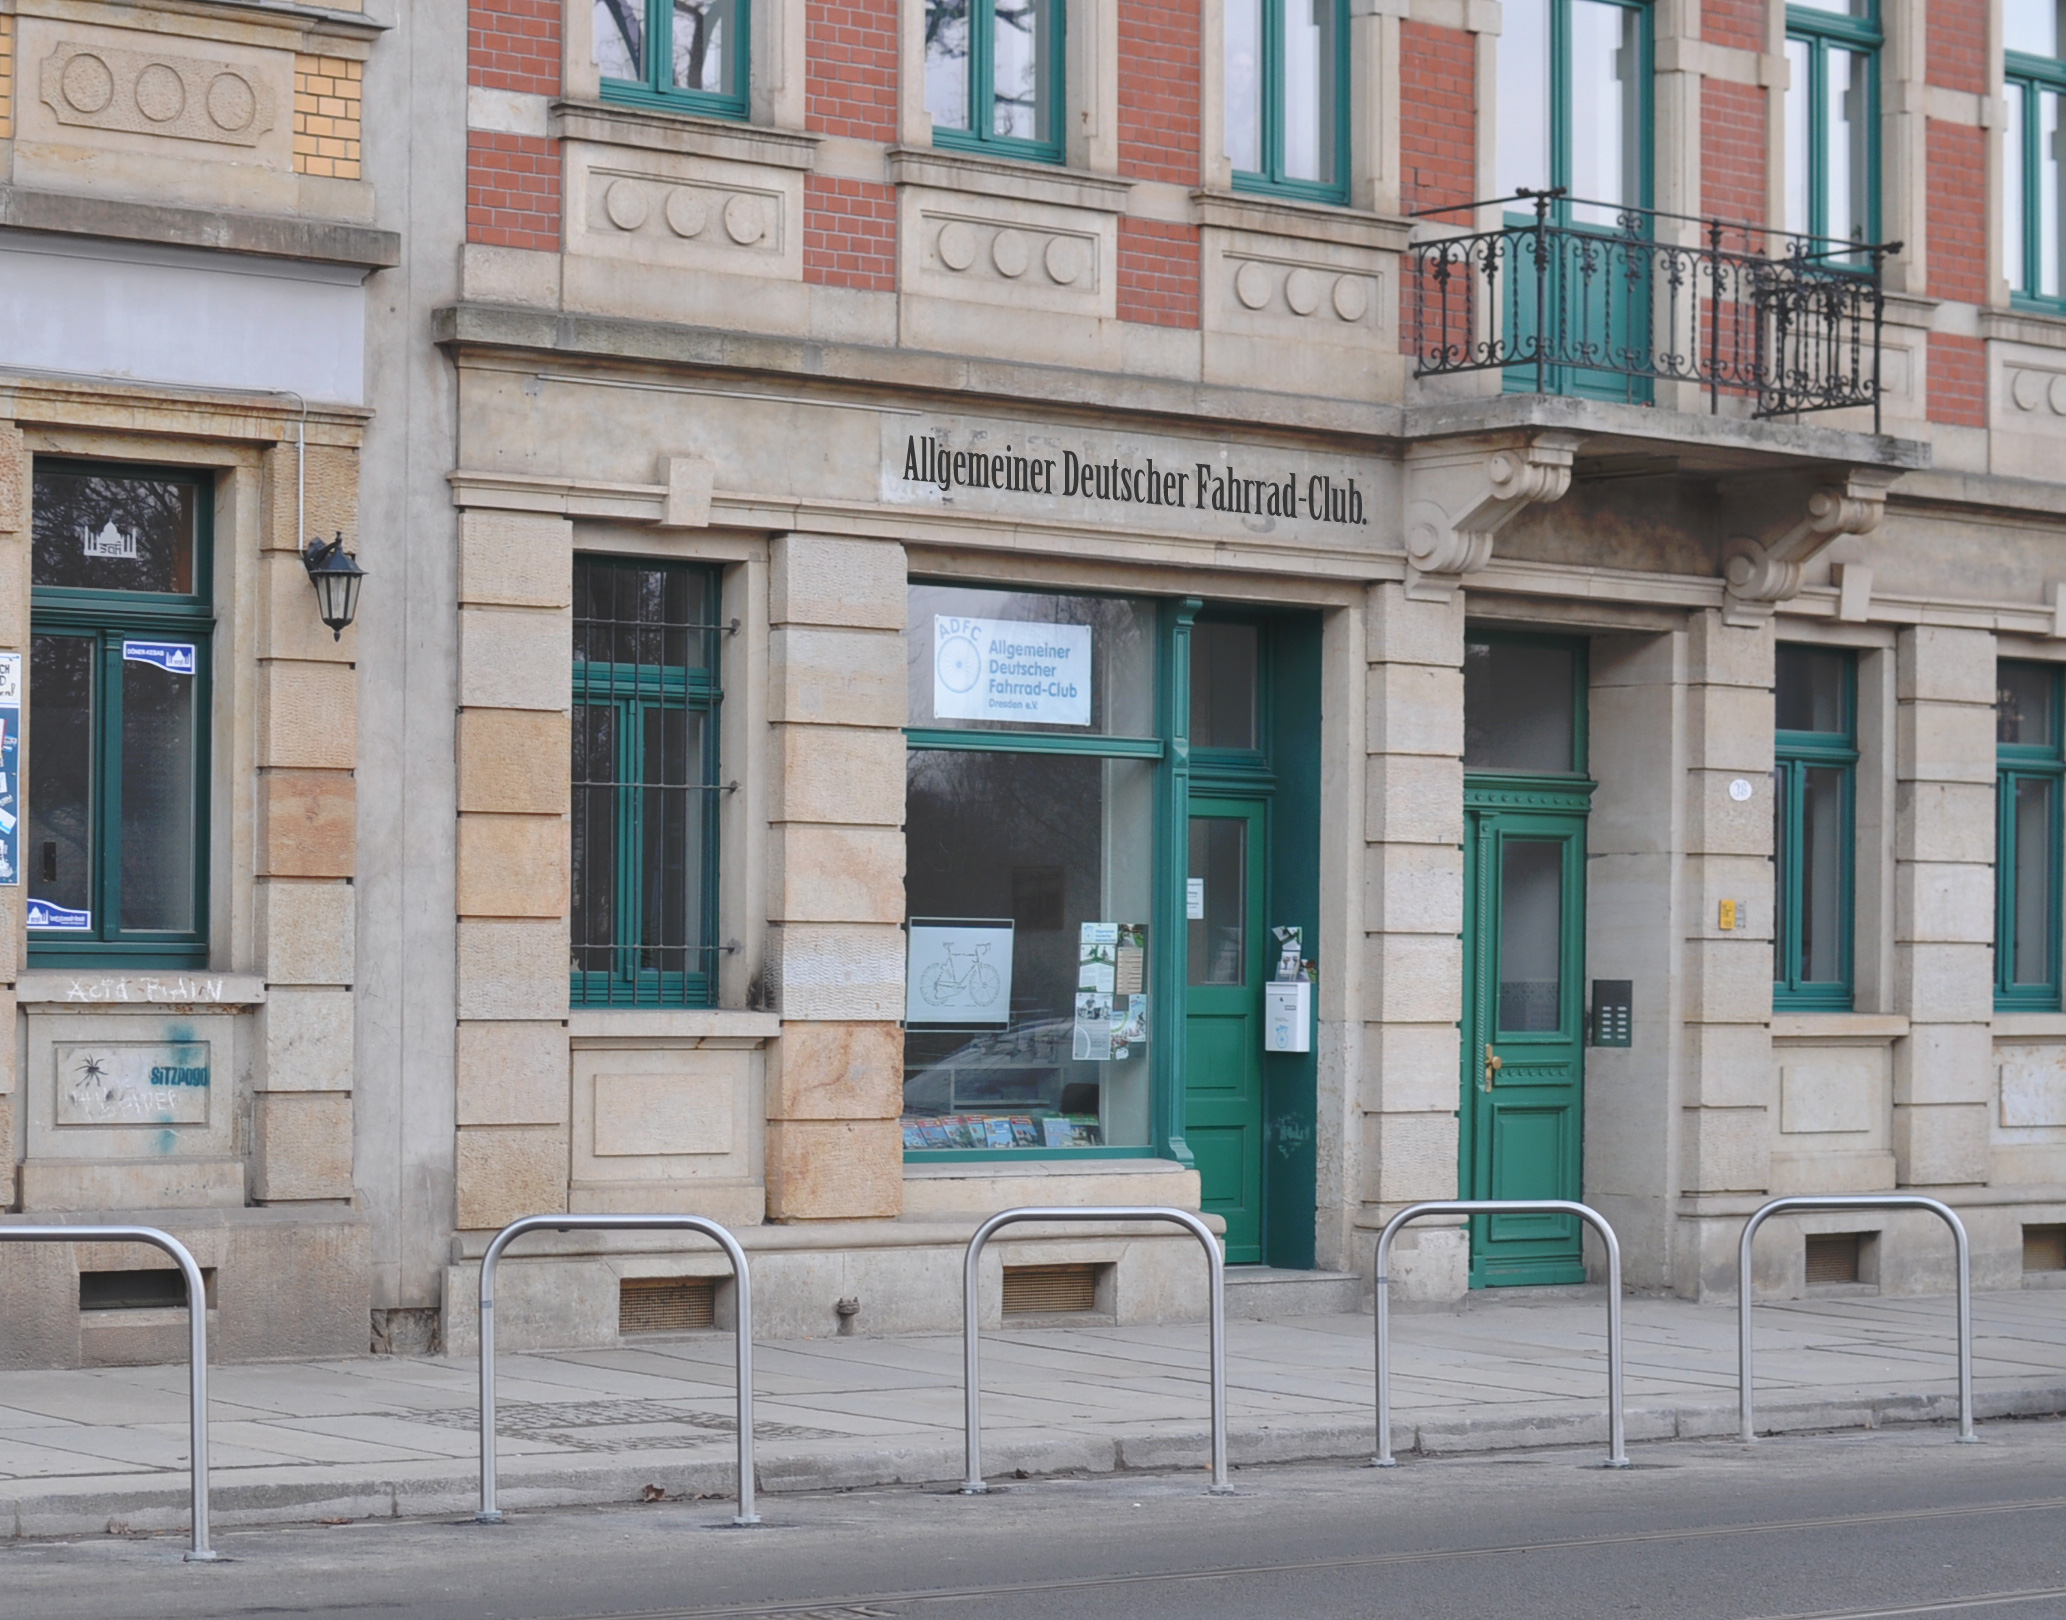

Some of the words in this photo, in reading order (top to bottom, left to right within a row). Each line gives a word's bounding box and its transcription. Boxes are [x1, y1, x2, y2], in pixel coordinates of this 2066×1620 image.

[902, 434, 1057, 494] Allgemeiner
[1062, 450, 1189, 508] Deutscher
[1195, 463, 1367, 526] Fahrrad-Club.
[939, 618, 982, 642] ADFC
[988, 639, 1071, 660] Allgemeiner
[989, 659, 1056, 677] Deutscher
[988, 678, 1078, 699] Fahrrad-Club
[989, 698, 1023, 709] Dresden
